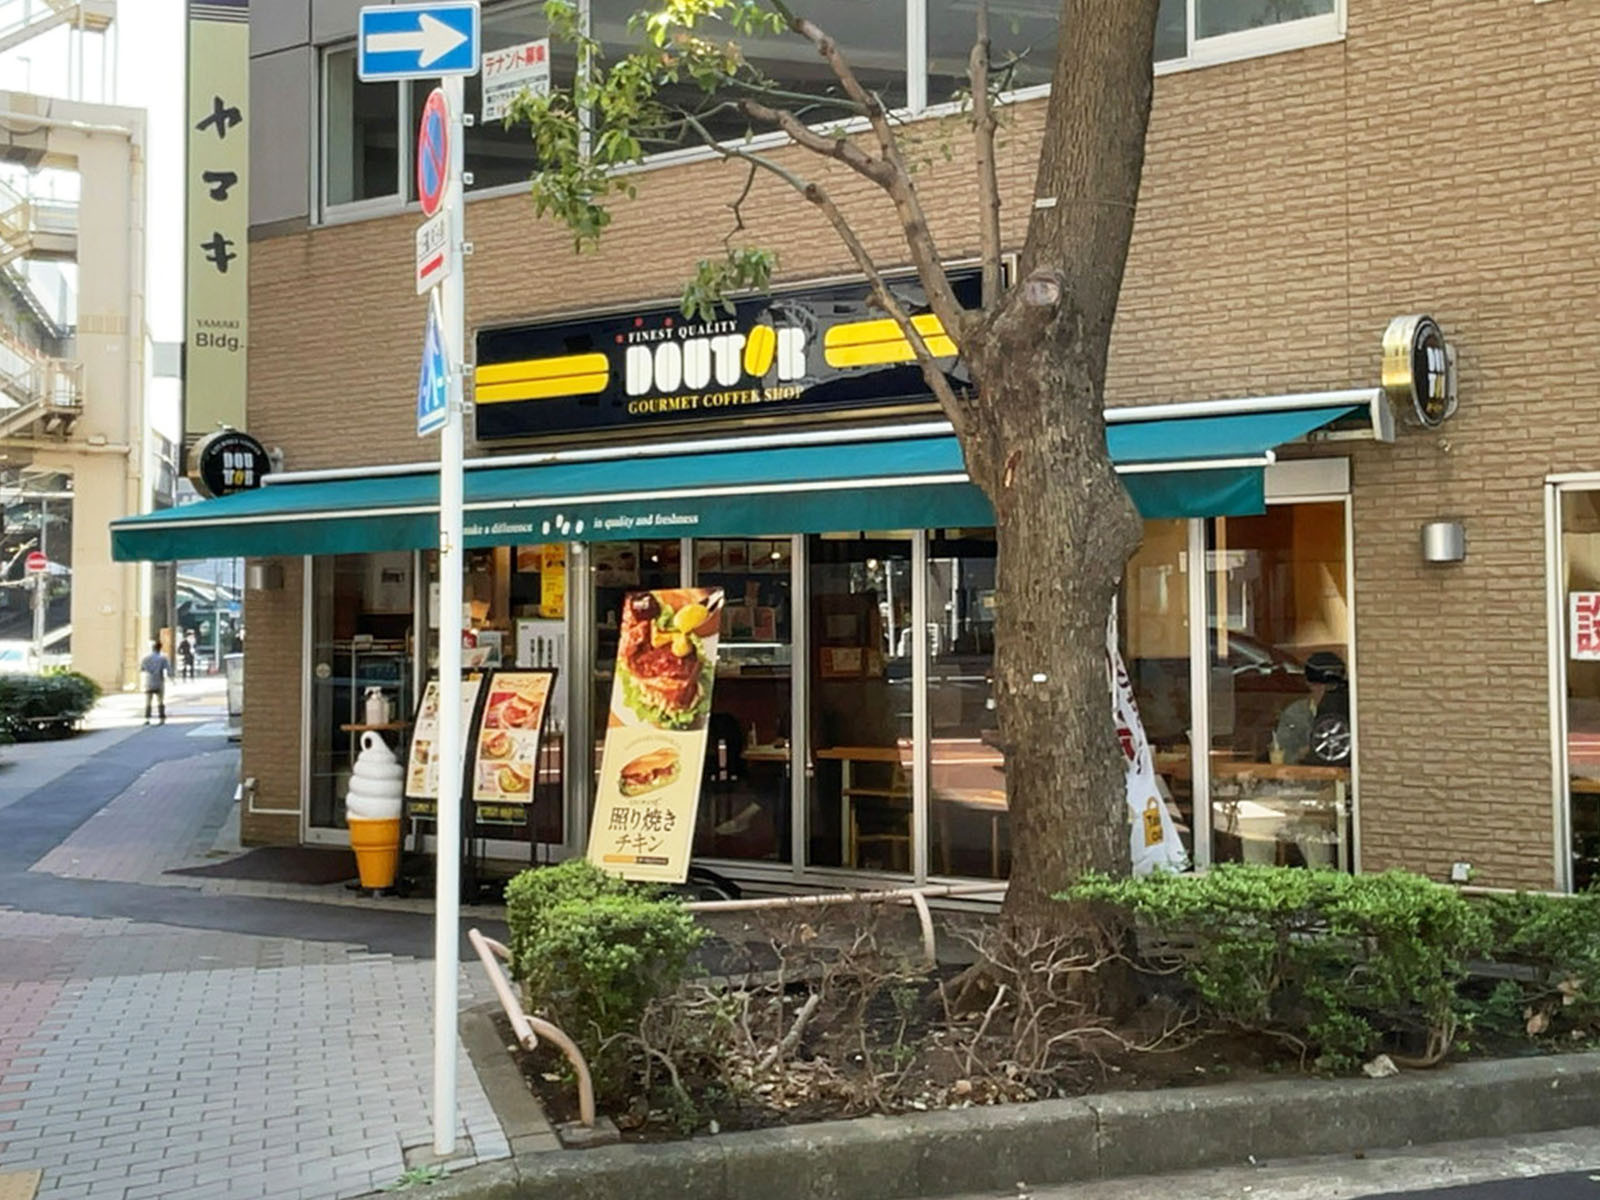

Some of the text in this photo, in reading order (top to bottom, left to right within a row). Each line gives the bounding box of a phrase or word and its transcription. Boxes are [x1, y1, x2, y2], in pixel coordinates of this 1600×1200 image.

[195, 96, 244, 274] ヤマキ
[196, 319, 240, 329] YAMAKI
[628, 320, 737, 343] FINEST QUALITY
[195, 332, 245, 352] Bldg.
[626, 324, 806, 396] DOUTOR
[628, 384, 804, 415] GOURMET COFFEE SHOP
[491, 522, 534, 534] difference
[593, 517, 603, 529] in
[604, 514, 634, 530] quality
[635, 513, 654, 526] and
[655, 513, 699, 526] freshness
[608, 807, 676, 832] 照り焼き
[615, 833, 664, 854] チキン
